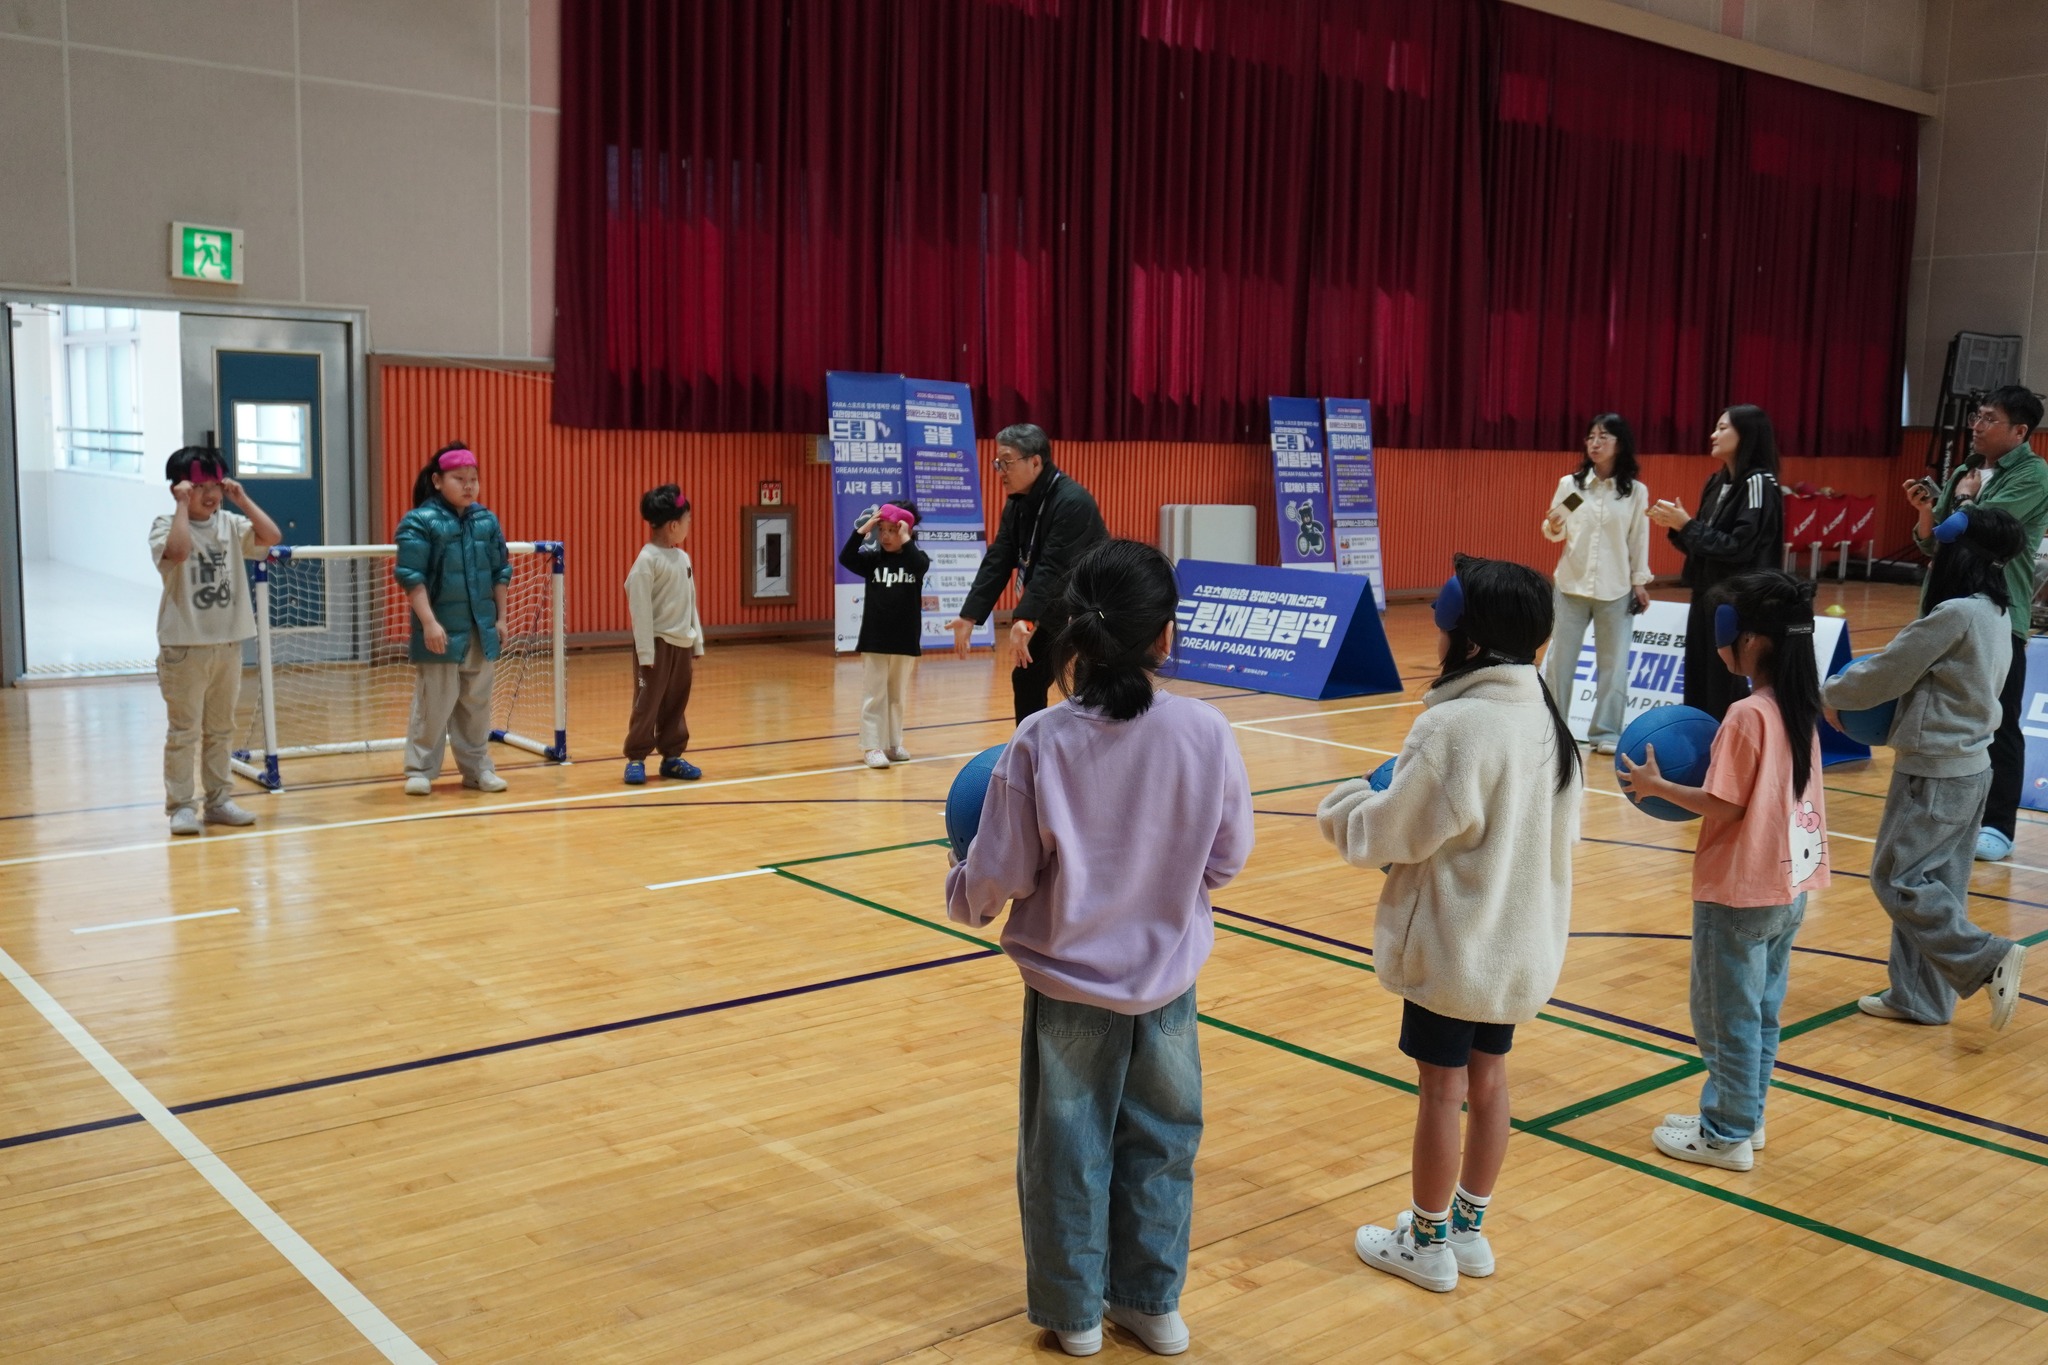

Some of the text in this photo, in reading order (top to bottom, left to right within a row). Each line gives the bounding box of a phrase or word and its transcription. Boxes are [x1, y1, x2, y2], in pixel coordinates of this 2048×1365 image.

[833, 420, 866, 440] 드림
[923, 424, 953, 446] 골볼
[1275, 434, 1299, 450] 드림
[833, 441, 902, 463] 패럴림픽
[1276, 451, 1323, 468] 패럴림픽
[835, 466, 902, 475] DREAM PARALYMPIC
[844, 480, 867, 495] 시각
[870, 481, 893, 495] 종목
[871, 567, 916, 588] Alpha
[1192, 585, 1250, 602] 스포츠체험형
[1179, 636, 1297, 663] DREAM PARALYMPIC
